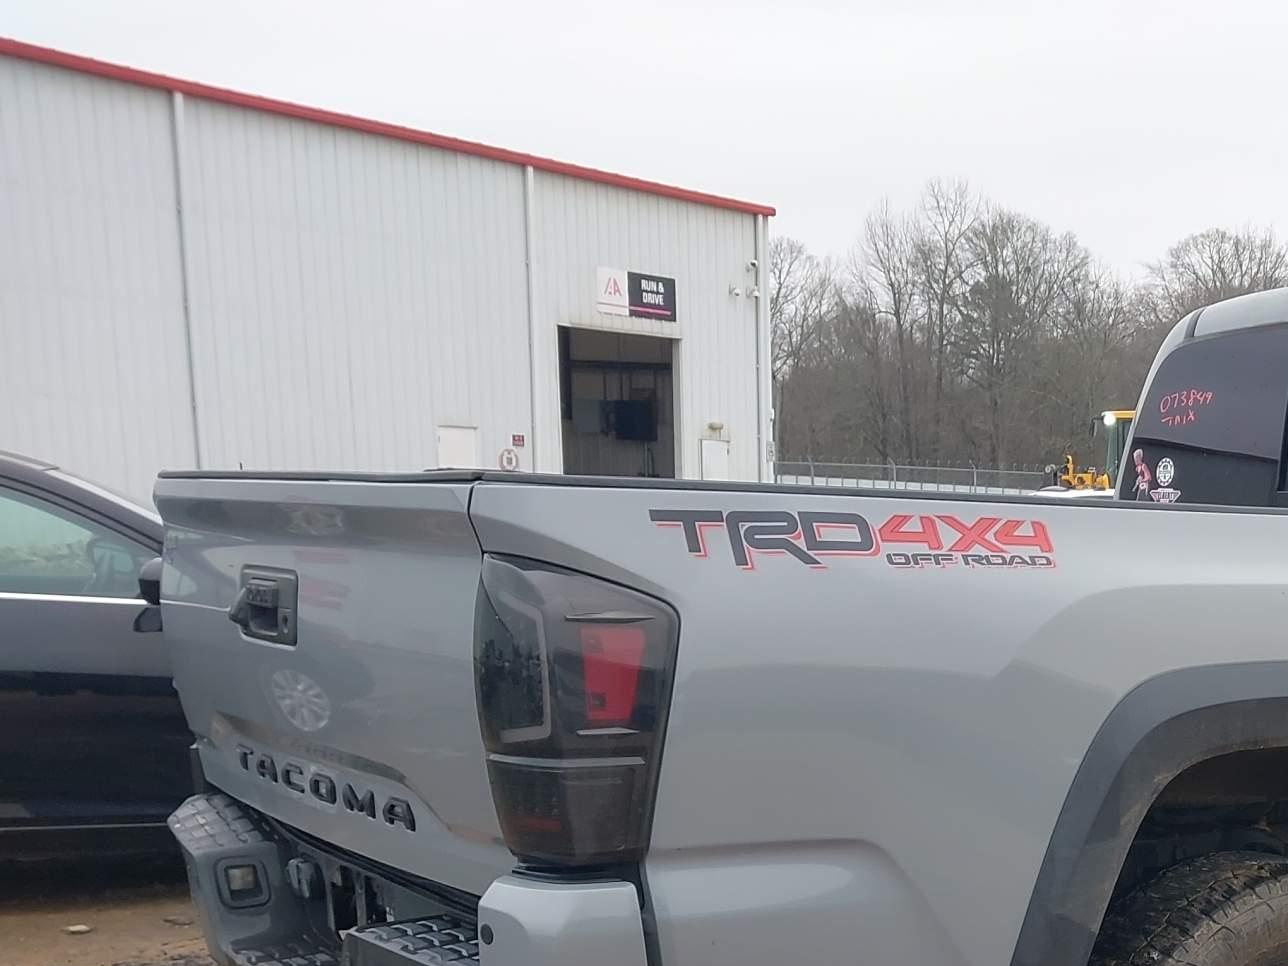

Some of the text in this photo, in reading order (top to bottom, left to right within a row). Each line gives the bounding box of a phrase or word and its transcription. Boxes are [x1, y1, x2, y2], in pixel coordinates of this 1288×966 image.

[641, 279, 656, 293] RUN
[642, 292, 664, 306] DRIVE
[885, 552, 1056, 569] OFF ROAD
[238, 743, 417, 832] TACOMA
